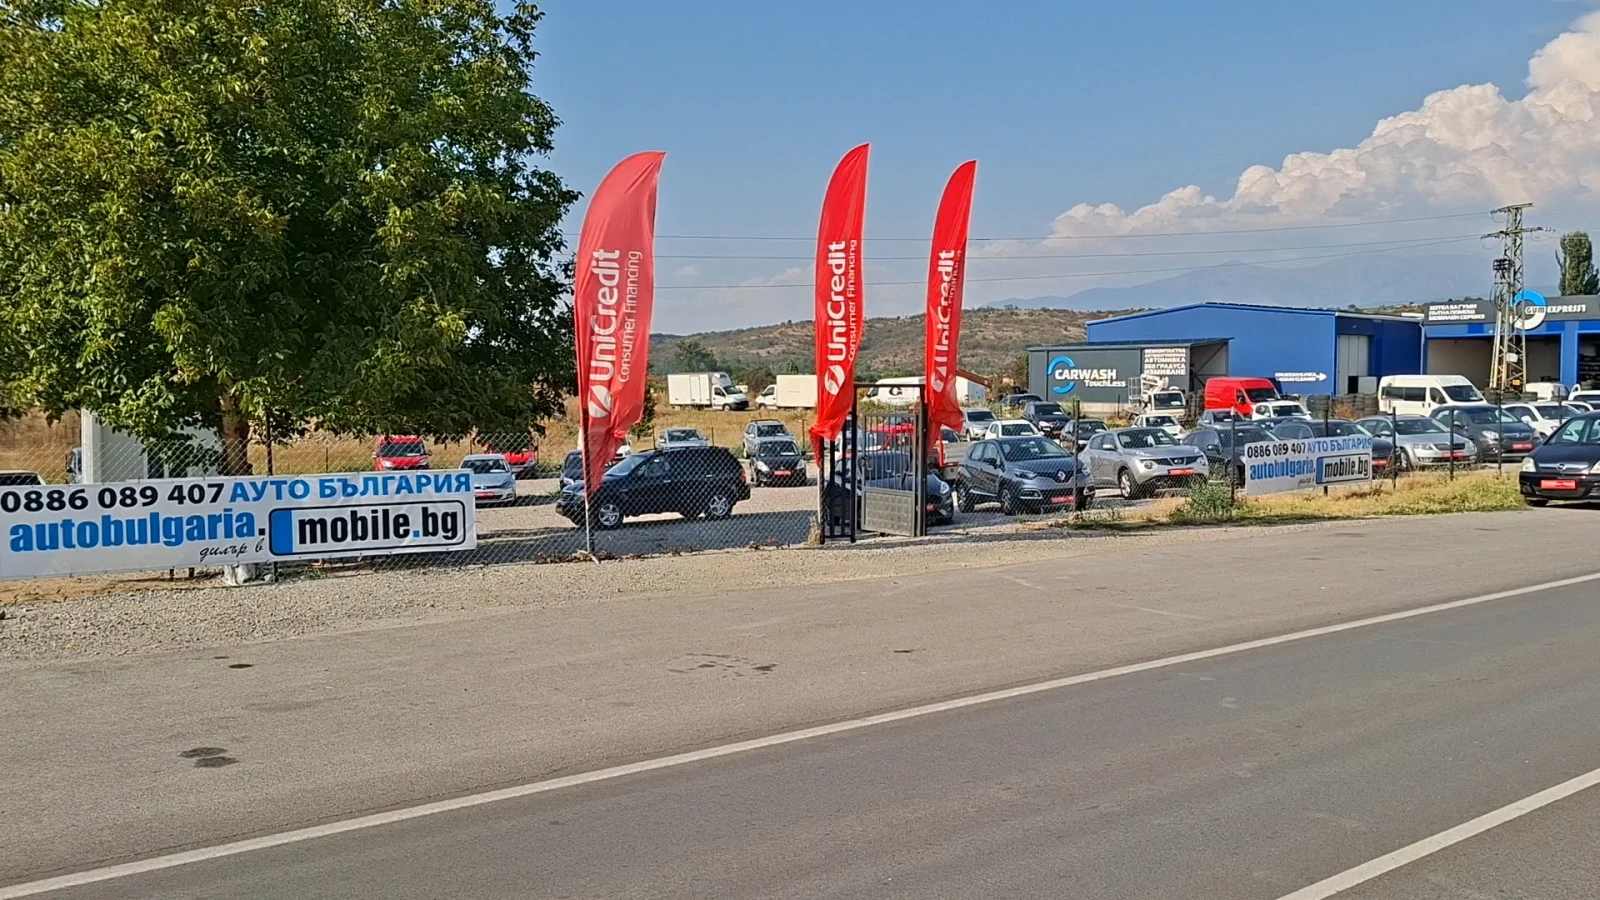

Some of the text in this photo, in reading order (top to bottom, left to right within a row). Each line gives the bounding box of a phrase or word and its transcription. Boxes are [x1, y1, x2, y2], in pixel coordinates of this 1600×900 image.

[590, 249, 621, 381] UniCredit
[619, 250, 643, 383] Consumer Financing
[827, 240, 848, 361] UniCredit
[847, 239, 858, 362] Consumer Financing
[1054, 368, 1117, 380] CARWASH
[1247, 436, 1372, 459] 0886 089 407 АУТО БЪЛГАРИЯ
[1324, 456, 1369, 478] mobile.bg
[0, 472, 471, 513] 0886 089 407 АУТО БЪЛГАРИЯ
[298, 506, 459, 545] mobile.bg
[199, 542, 249, 563] дилър
